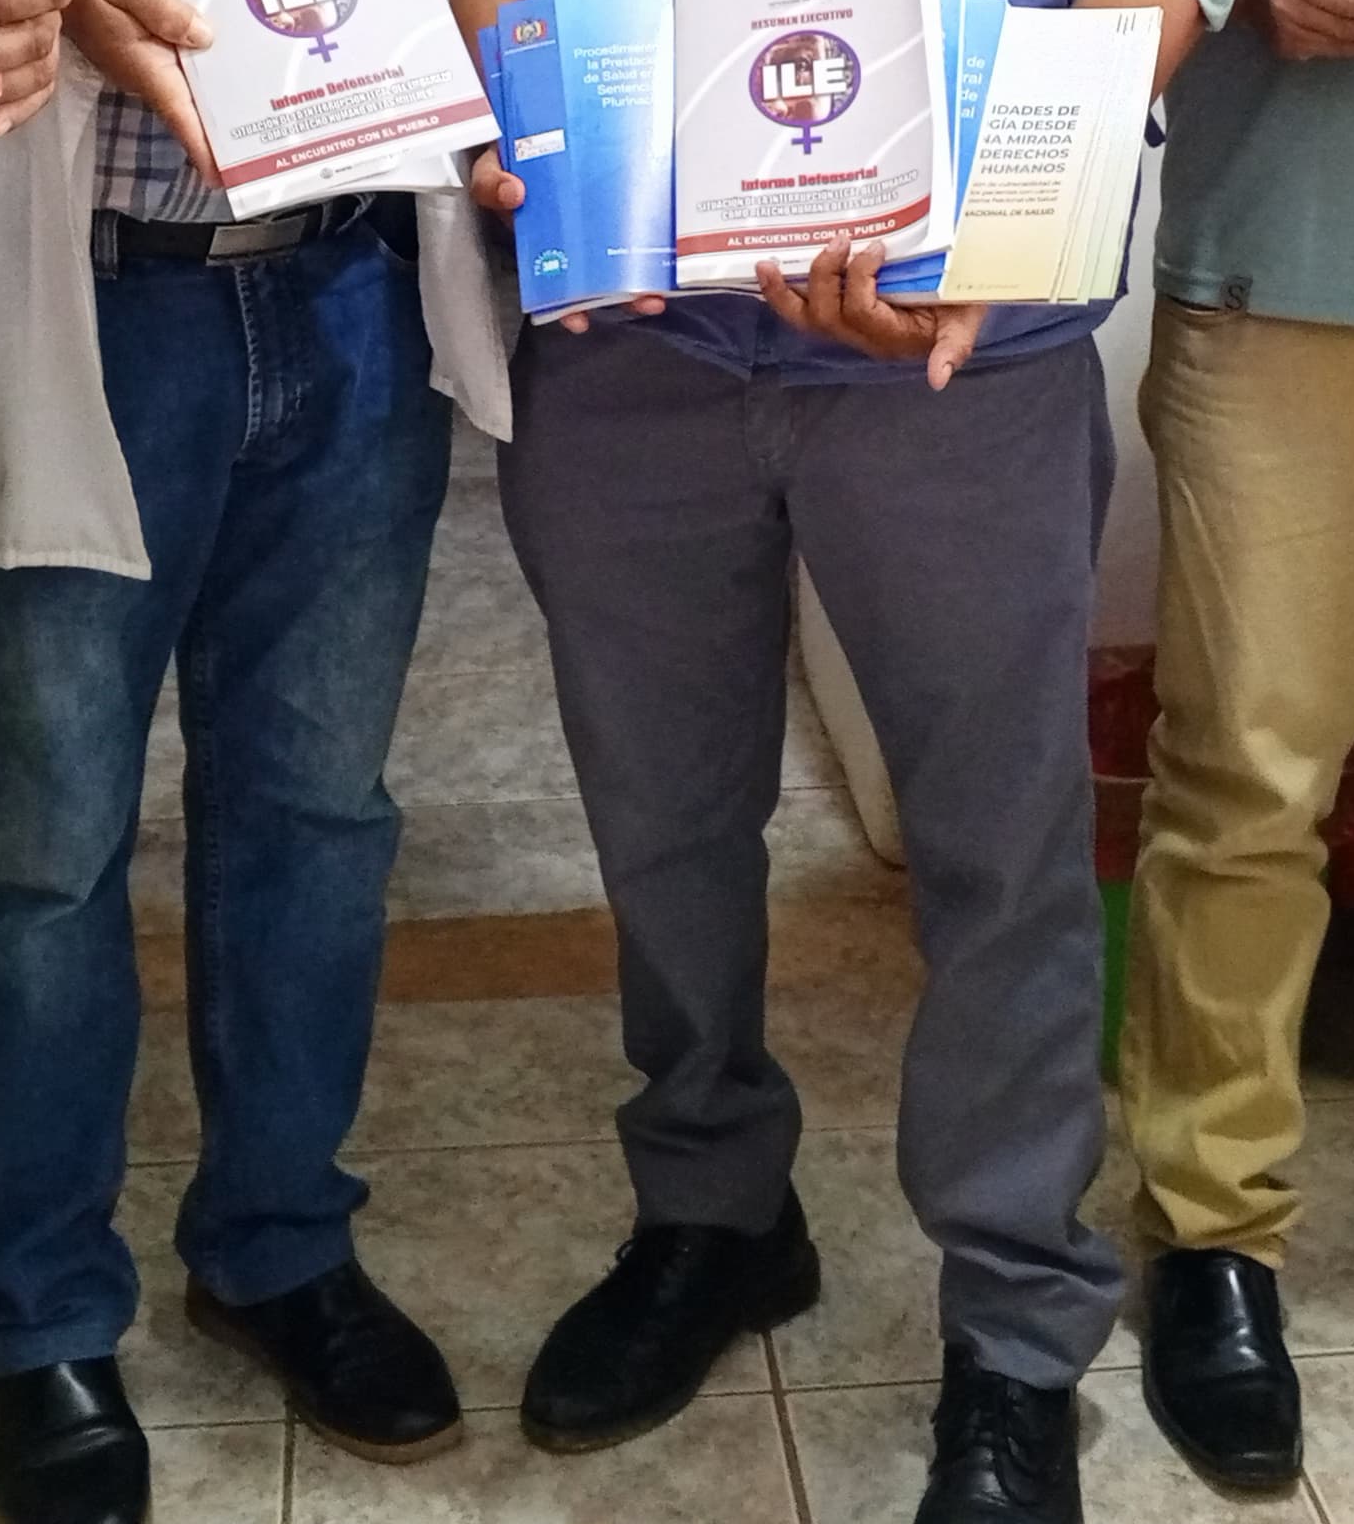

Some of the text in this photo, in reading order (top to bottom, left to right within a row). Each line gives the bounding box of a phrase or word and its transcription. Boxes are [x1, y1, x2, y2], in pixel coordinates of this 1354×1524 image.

[751, 8, 853, 30] RESUMEN EJECUTIVO
[587, 59, 598, 70] la
[967, 56, 985, 68] de
[583, 74, 599, 84] de
[602, 68, 637, 82] Salud
[762, 58, 846, 100] ILE
[270, 66, 405, 111] Informe Defensorial
[1057, 106, 1081, 116] DE
[1021, 120, 1077, 131] DESDE
[276, 115, 440, 168] AL ENCUENTRO CON EL PUEBLO
[1007, 134, 1073, 145] MIRADA
[980, 149, 1070, 159] DERECHOS
[981, 163, 1066, 174] HUMANOS
[741, 166, 878, 192] Informe Defensorial
[727, 238, 741, 246] AL
[744, 233, 810, 245] ENCUENTRO
[812, 230, 836, 240] CON
[854, 219, 895, 235] PUEBLO
